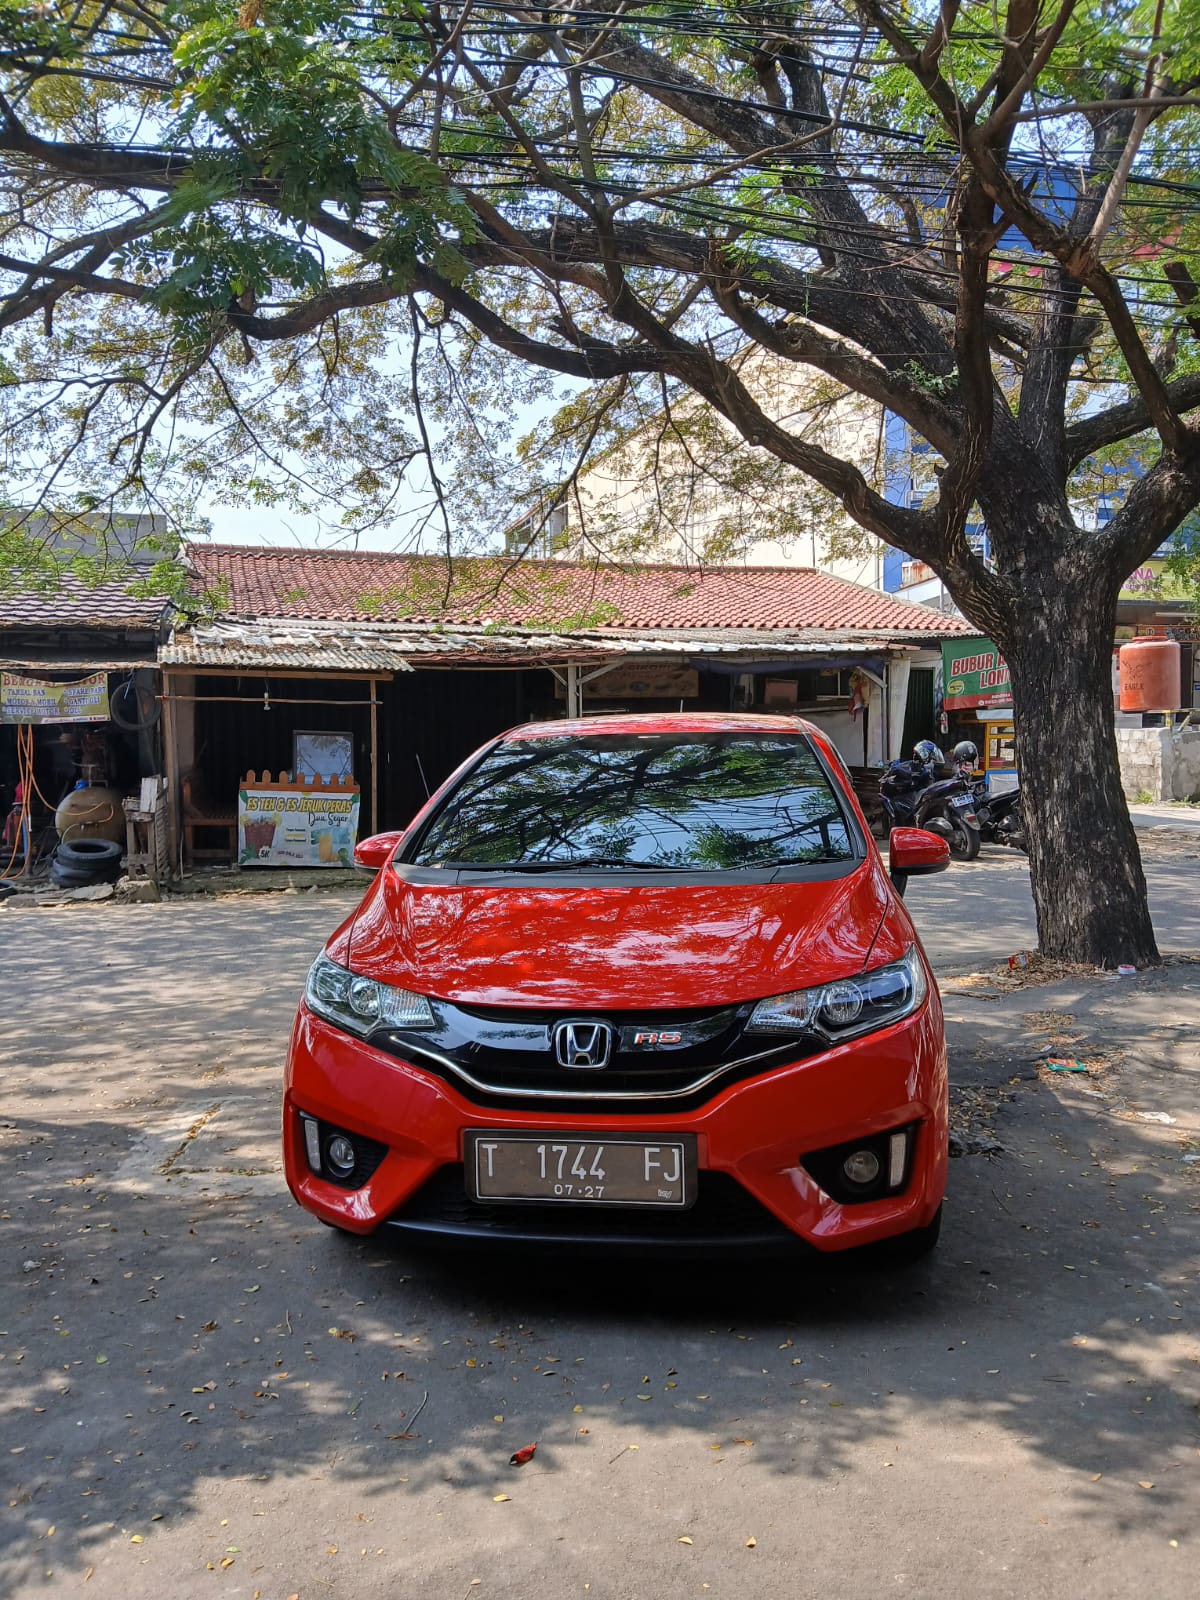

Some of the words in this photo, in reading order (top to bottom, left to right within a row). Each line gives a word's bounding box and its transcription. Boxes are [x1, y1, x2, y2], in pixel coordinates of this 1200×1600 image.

[951, 653, 994, 676] BUBUR
[246, 797, 258, 811] ES
[260, 797, 277, 811] TEH
[277, 797, 285, 812] &
[285, 798, 298, 812] ES
[298, 798, 325, 813] JERUK
[324, 799, 353, 813] PERAS
[634, 1031, 682, 1045] RS
[481, 1144, 498, 1177] T
[537, 1144, 606, 1180] 1744
[644, 1147, 681, 1182] FJ
